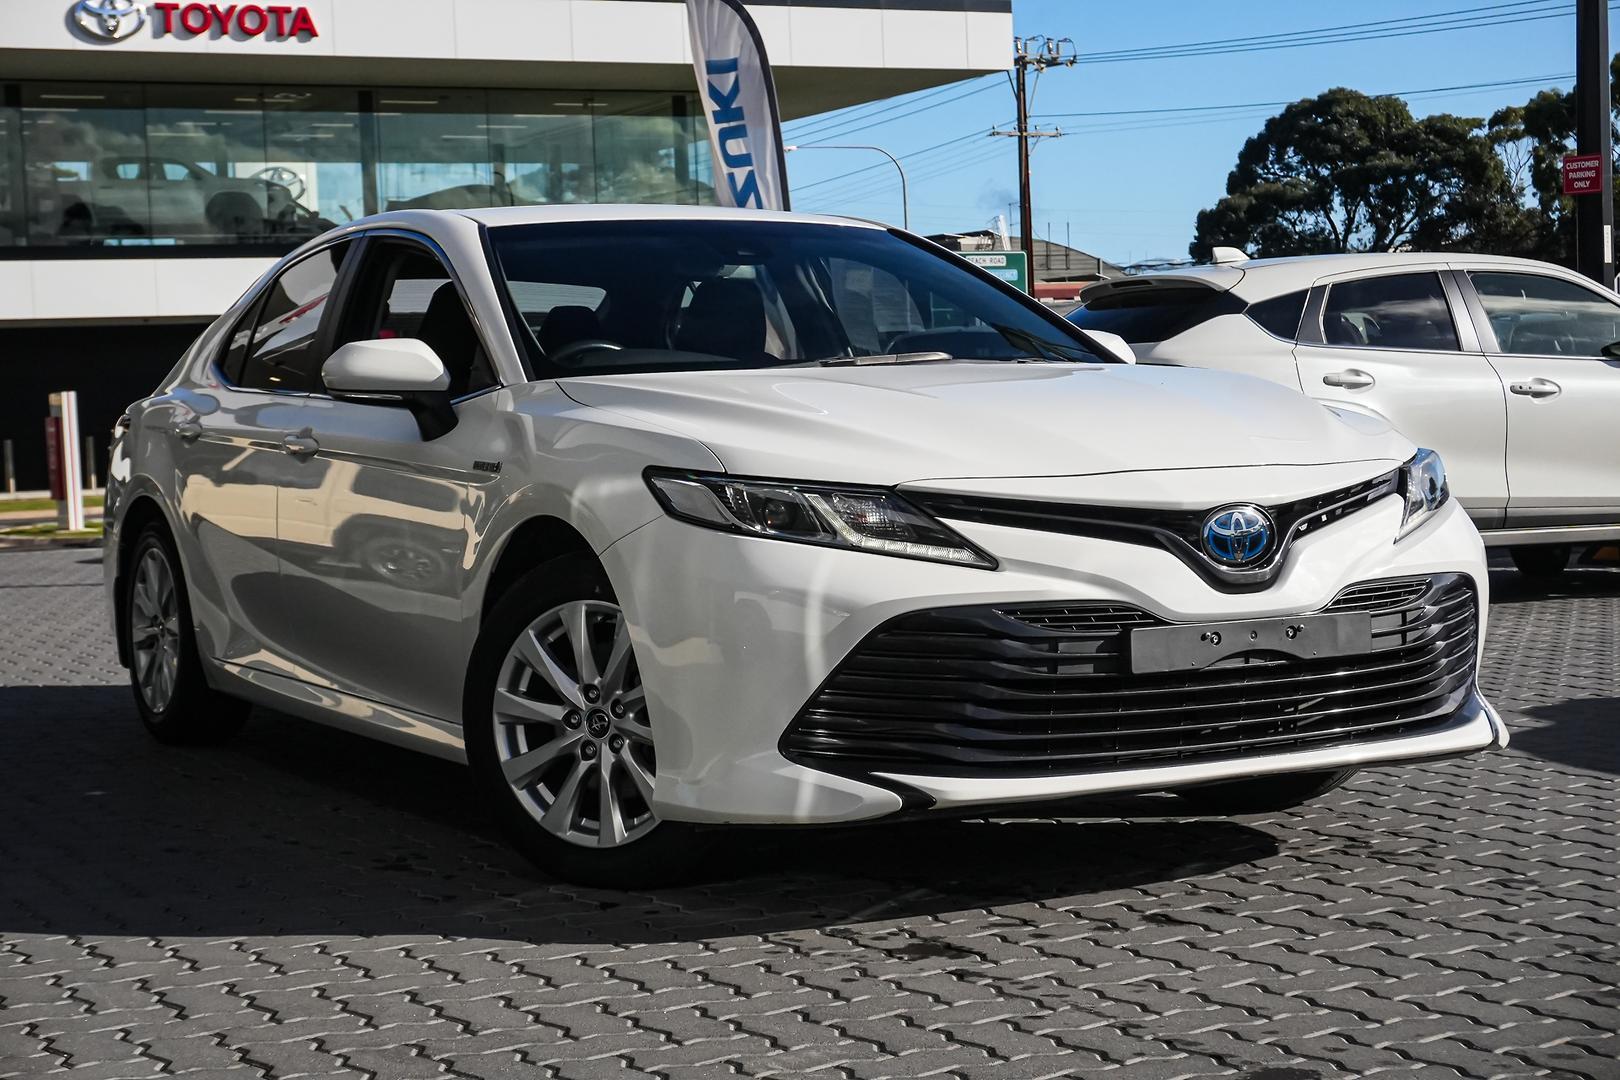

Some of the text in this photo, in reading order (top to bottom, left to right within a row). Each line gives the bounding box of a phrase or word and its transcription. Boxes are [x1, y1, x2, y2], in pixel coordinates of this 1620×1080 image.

[154, 2, 319, 38] TOYOTA
[1566, 160, 1599, 170] CUSTOMER
[1568, 170, 1596, 178] PARKING
